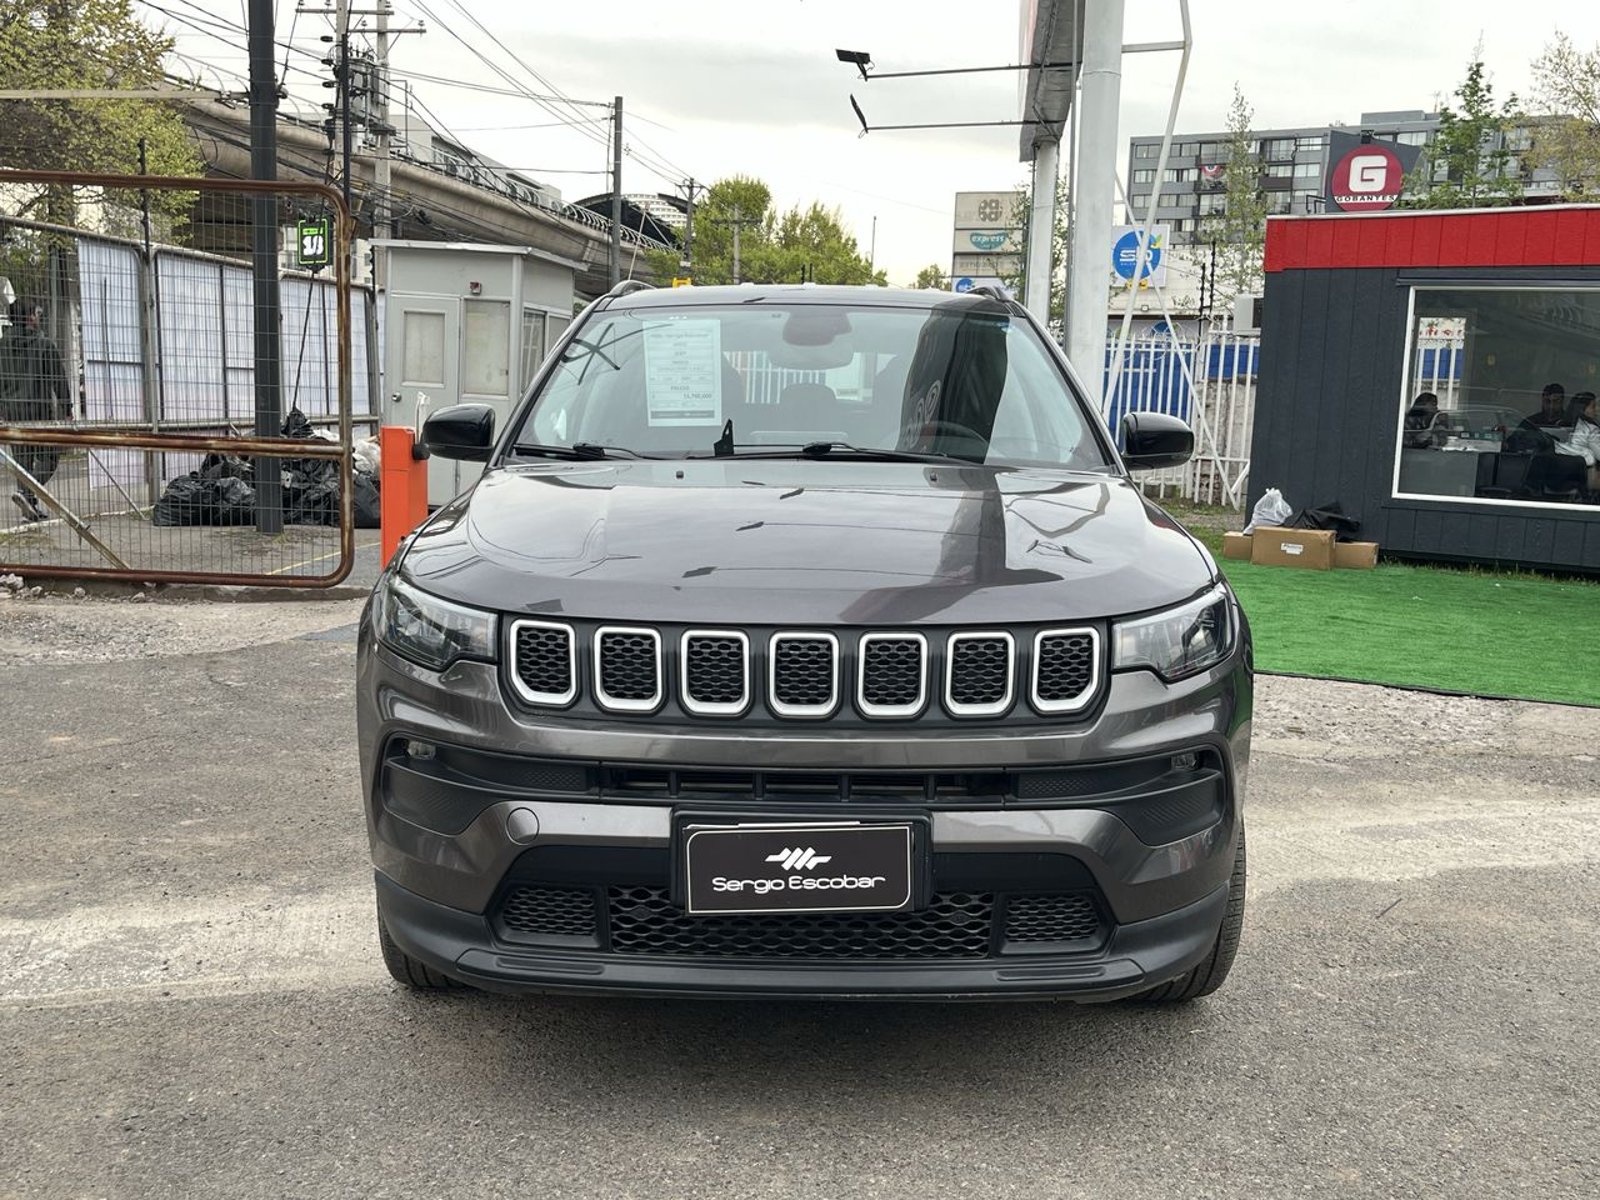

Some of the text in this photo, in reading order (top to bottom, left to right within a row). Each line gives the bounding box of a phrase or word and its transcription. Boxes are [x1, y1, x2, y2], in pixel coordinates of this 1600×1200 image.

[1349, 155, 1388, 193] G
[712, 874, 886, 894] Sergio Escobar
